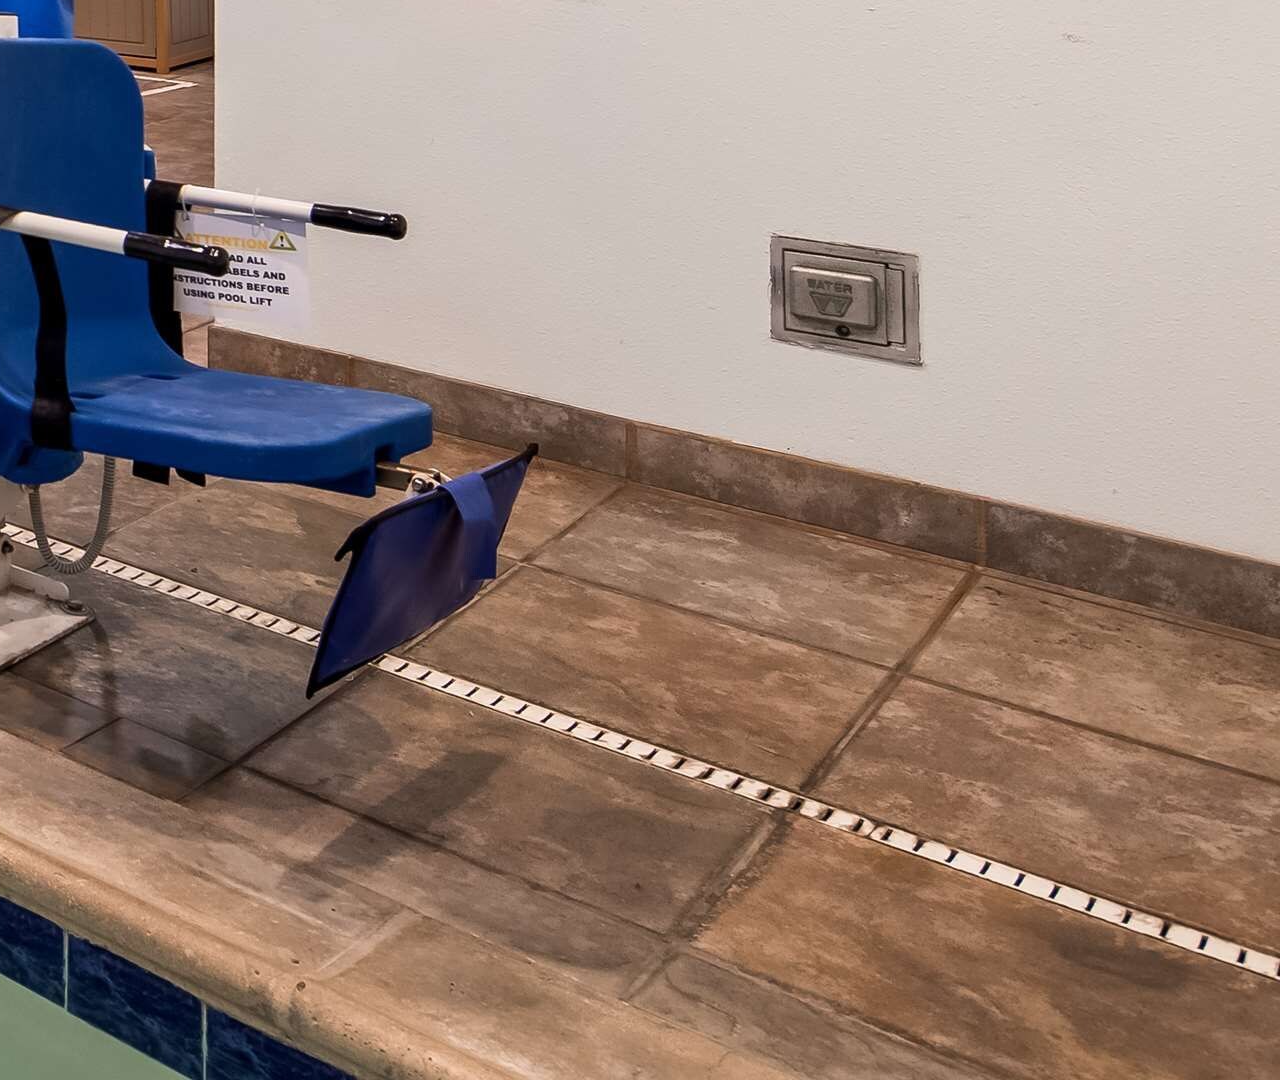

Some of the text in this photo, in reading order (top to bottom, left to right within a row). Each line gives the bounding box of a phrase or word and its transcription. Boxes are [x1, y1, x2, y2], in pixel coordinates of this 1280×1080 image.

[185, 233, 269, 250] ATTENTION
[246, 256, 268, 266] ALL
[228, 267, 286, 281] BELS AND
[174, 274, 290, 295] STRUCTIONS BEFORE
[183, 288, 273, 307] USING POOL LIFT
